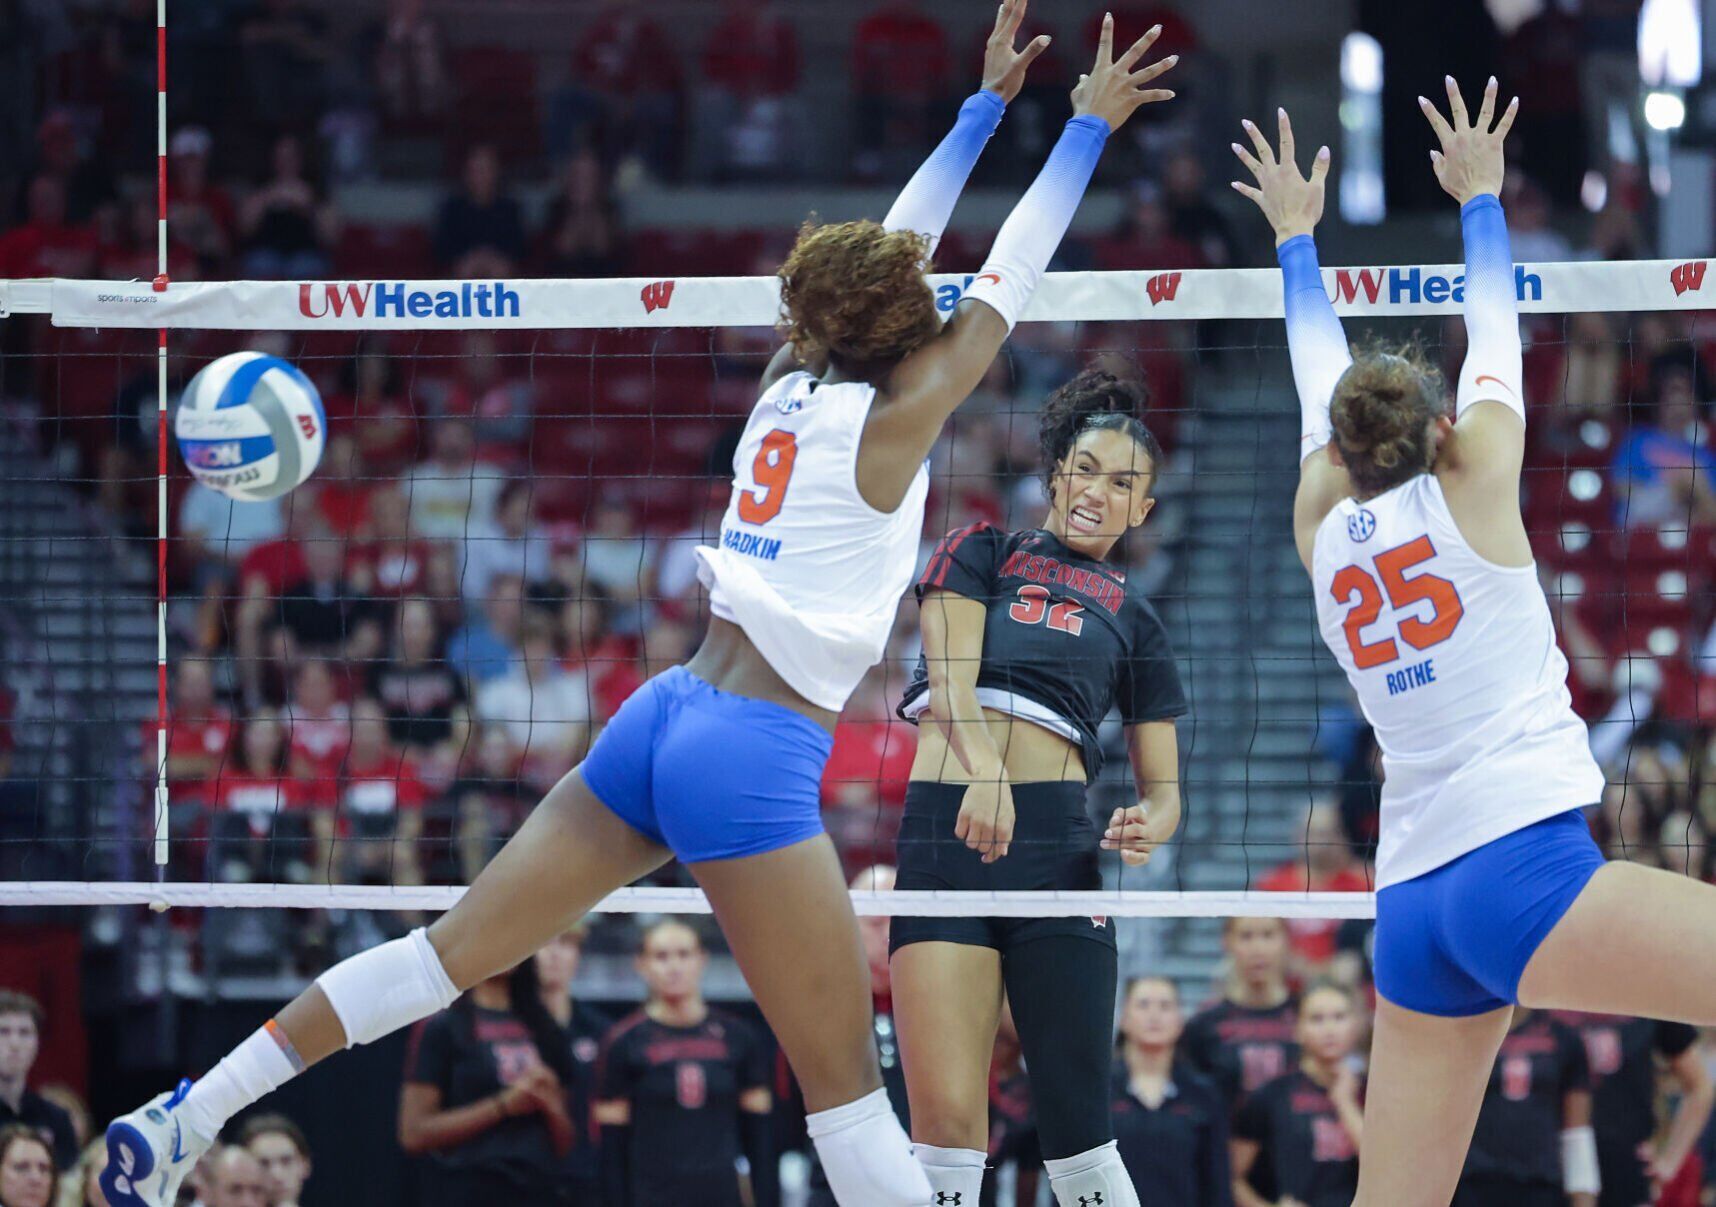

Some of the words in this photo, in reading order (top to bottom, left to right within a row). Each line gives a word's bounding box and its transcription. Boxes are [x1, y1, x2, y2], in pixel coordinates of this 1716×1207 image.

[1146, 272, 1182, 306] W
[1670, 261, 1707, 297] W
[97, 294, 123, 303] sports
[641, 281, 675, 314] W
[738, 428, 799, 526] 9
[1009, 584, 1086, 637] 32
[1330, 534, 1464, 670] 25
[1386, 659, 1436, 695] ROTHE
